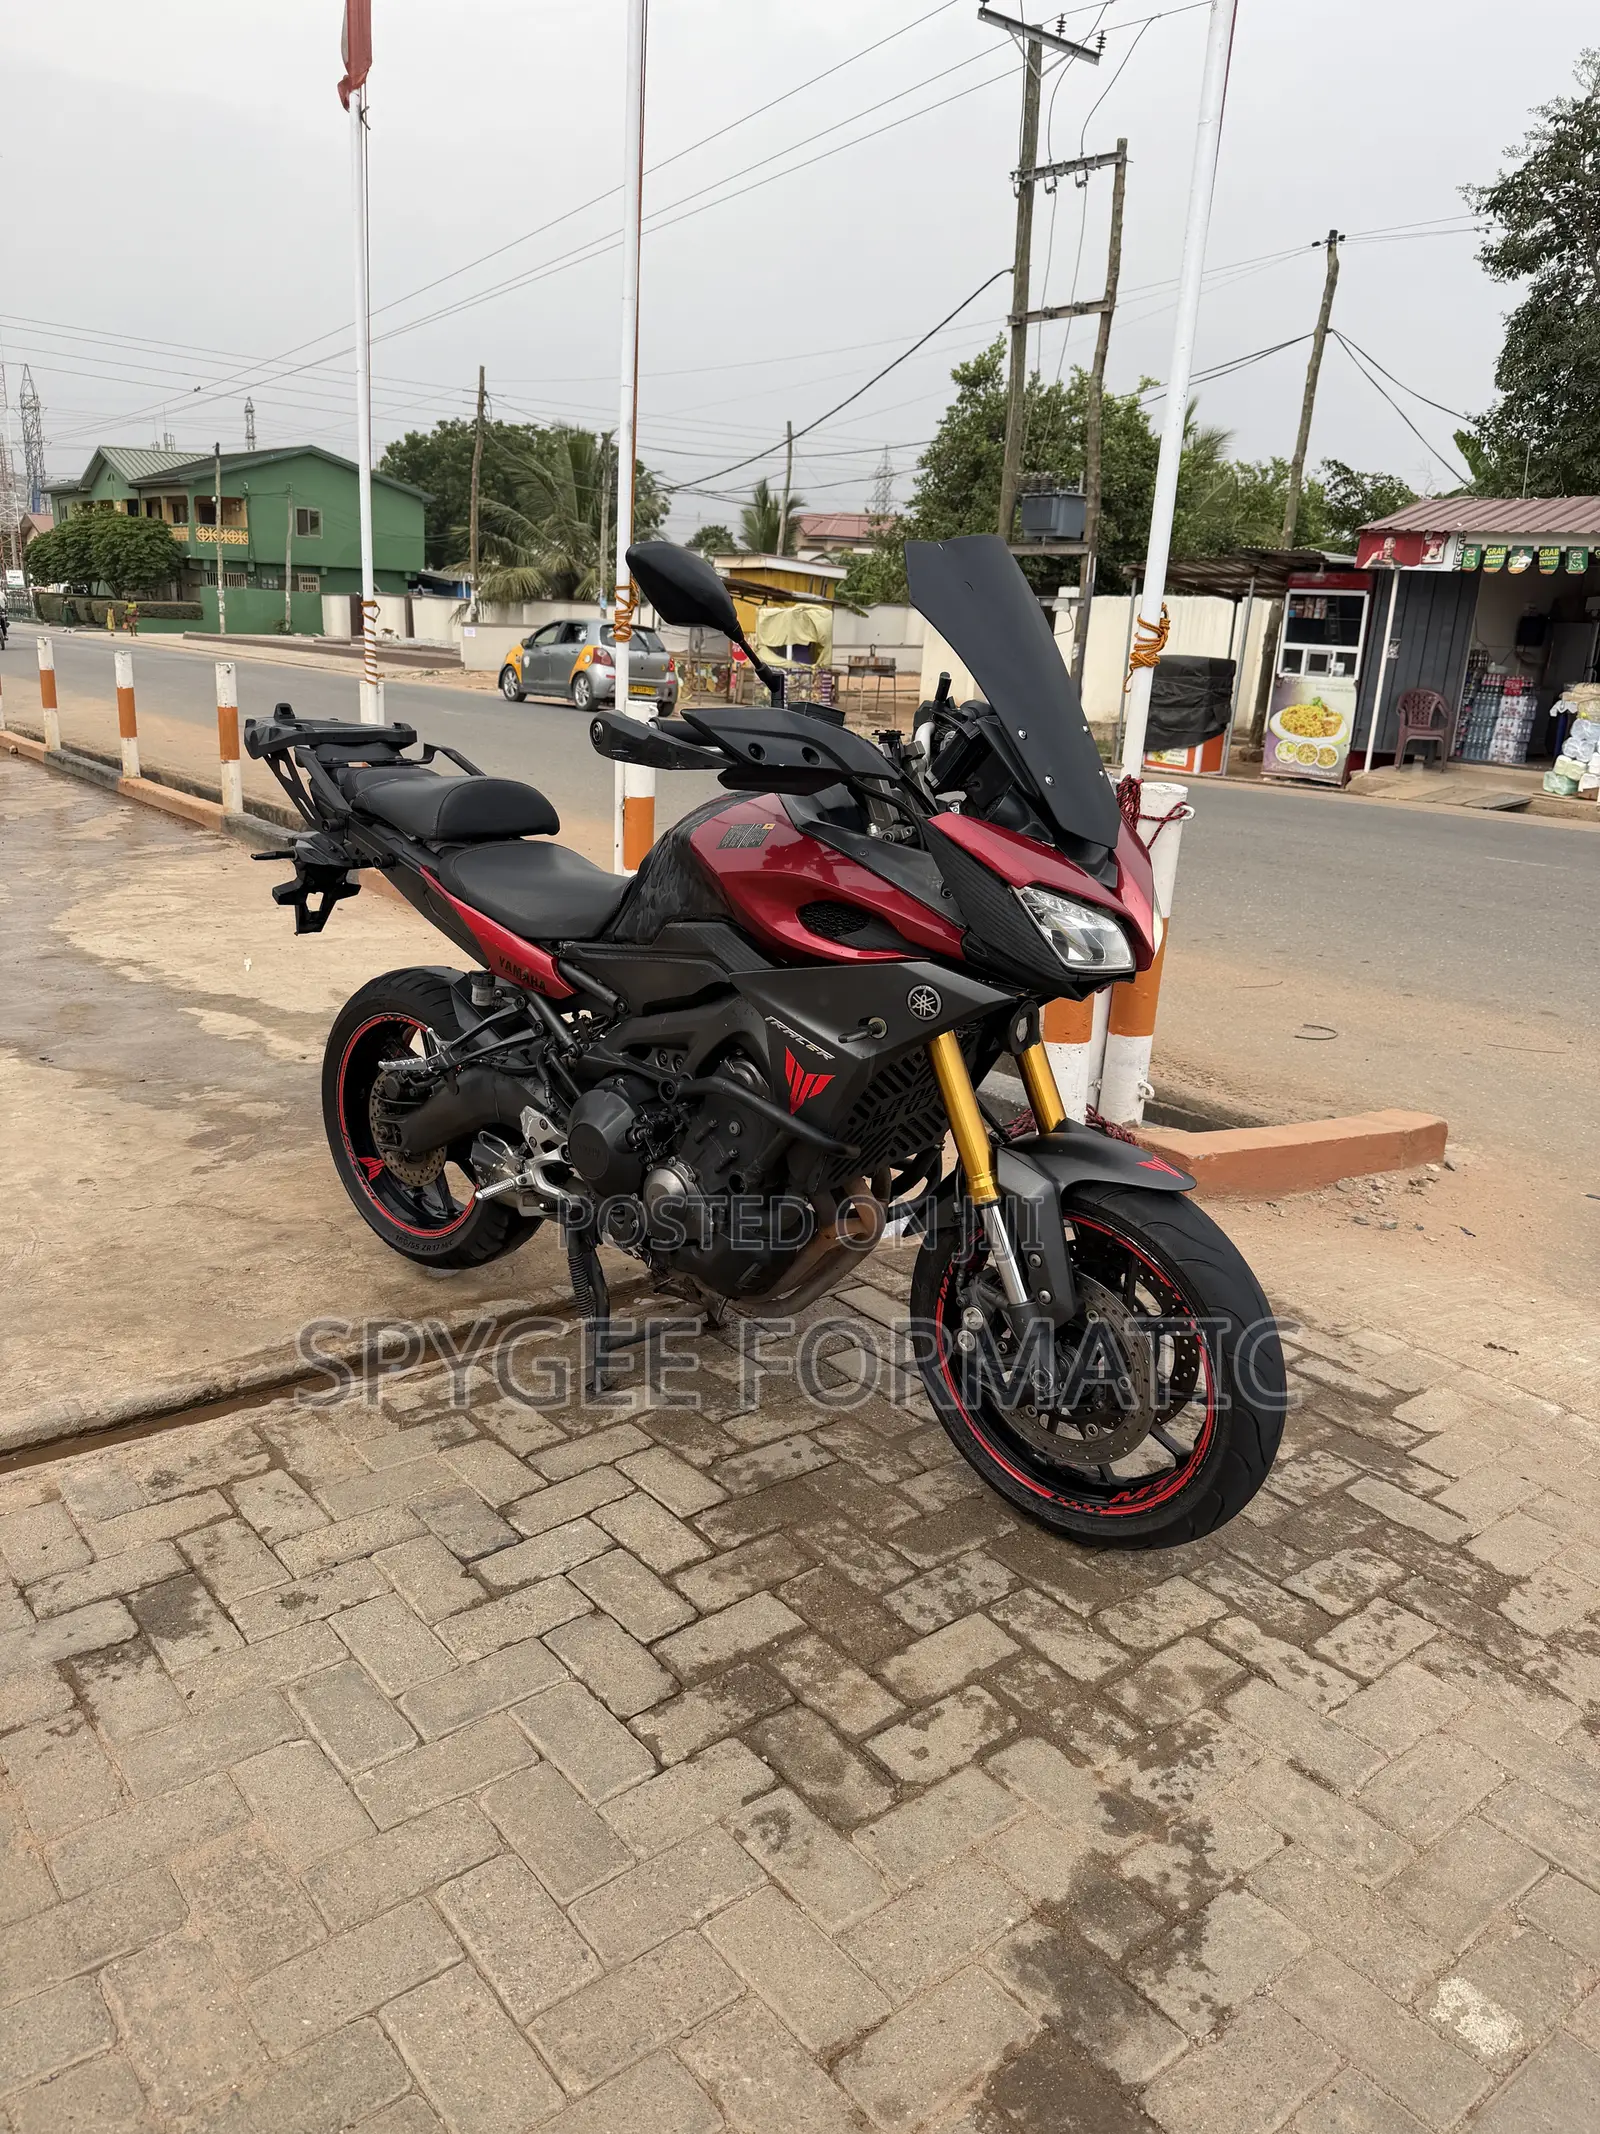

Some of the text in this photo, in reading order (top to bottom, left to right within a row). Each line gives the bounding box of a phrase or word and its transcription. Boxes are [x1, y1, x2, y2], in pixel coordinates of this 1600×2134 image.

[1486, 547, 1506, 556] GRAB
[1539, 548, 1559, 556] GRAB
[499, 956, 546, 992] YAMAHA
[765, 1016, 836, 1060] TRACER
